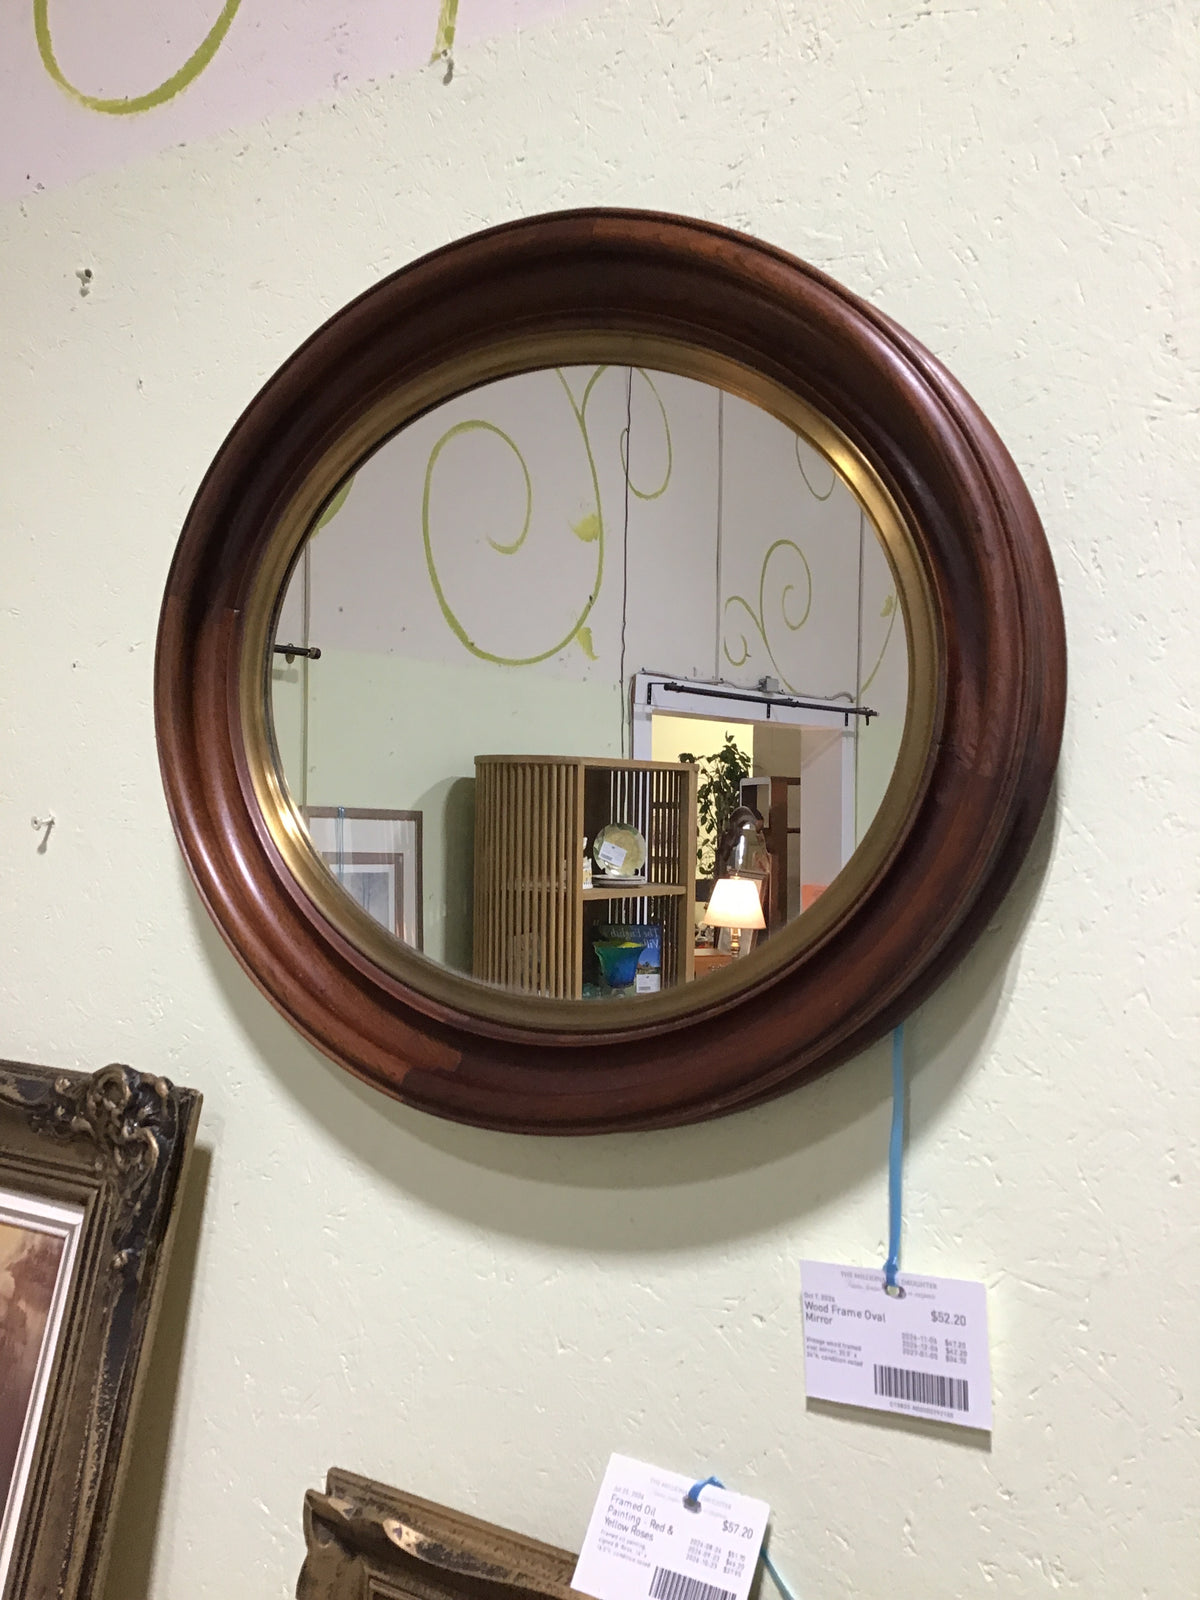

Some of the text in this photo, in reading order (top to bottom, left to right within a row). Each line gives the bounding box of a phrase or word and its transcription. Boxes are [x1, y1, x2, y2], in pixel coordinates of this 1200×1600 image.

[804, 1302, 886, 1323] Wood Frame Oval
[805, 1312, 832, 1325] Mirror
[931, 1310, 967, 1326] $52.20
[611, 1494, 642, 1513] Framed
[644, 1505, 656, 1516] Oil
[605, 1516, 654, 1541] Yellow Roses
[607, 1505, 641, 1525] Painting
[650, 1519, 665, 1532] Red
[667, 1525, 674, 1535] &
[722, 1520, 753, 1539] $57.20
